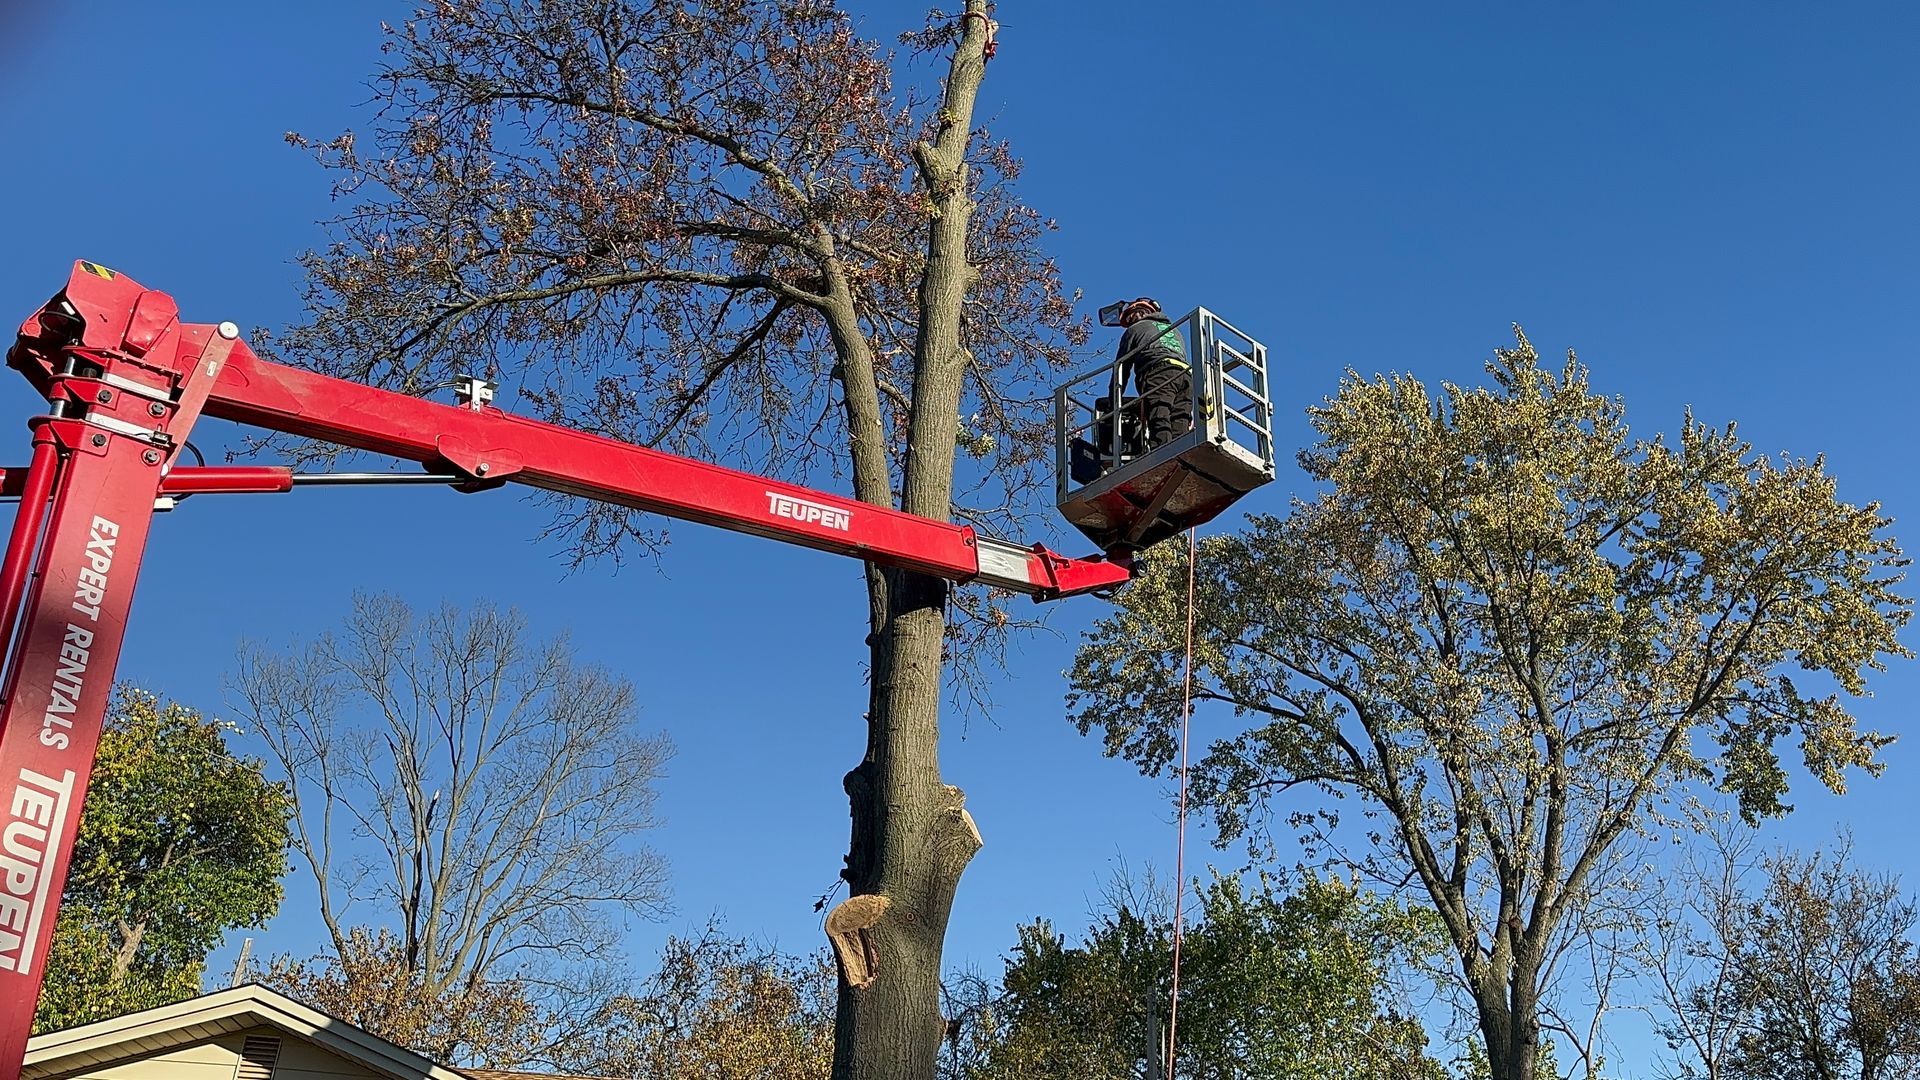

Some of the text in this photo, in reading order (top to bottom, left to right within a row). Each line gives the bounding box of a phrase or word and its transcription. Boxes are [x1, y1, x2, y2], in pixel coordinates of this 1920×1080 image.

[765, 491, 850, 531] TEUPEN
[40, 515, 120, 750] EXPERT RENTALS
